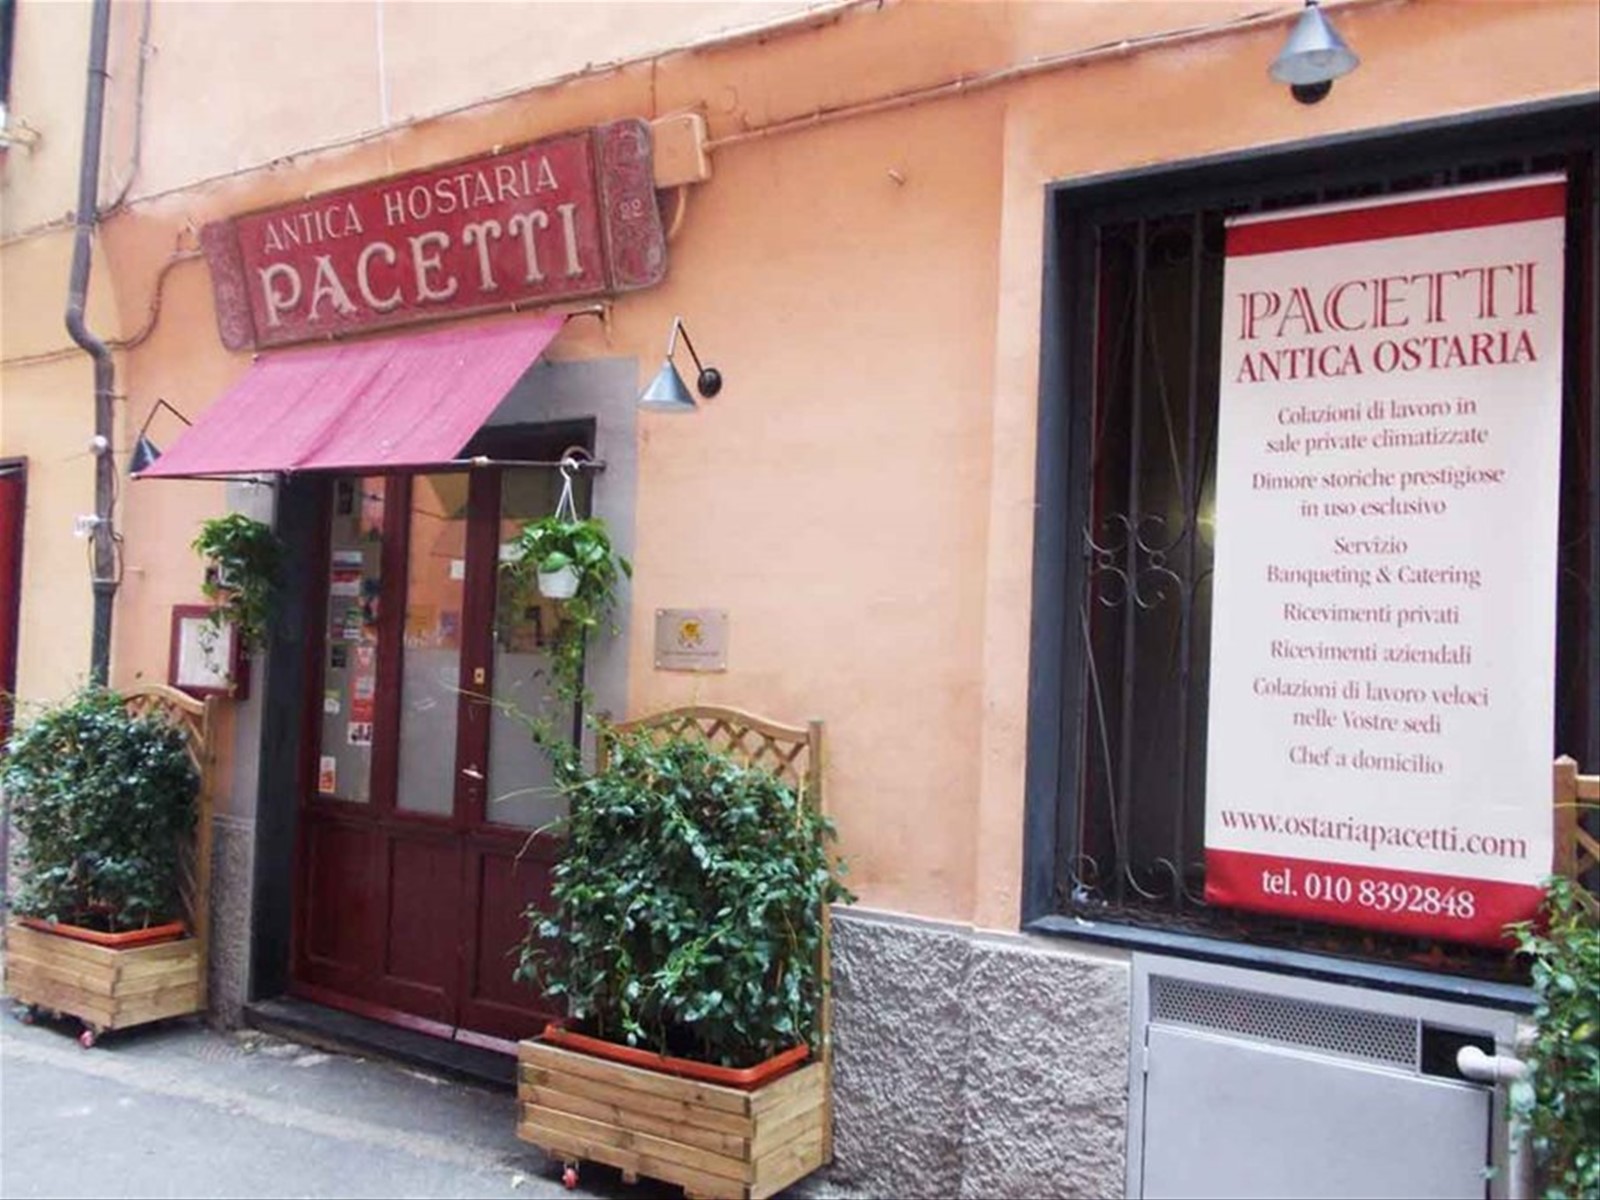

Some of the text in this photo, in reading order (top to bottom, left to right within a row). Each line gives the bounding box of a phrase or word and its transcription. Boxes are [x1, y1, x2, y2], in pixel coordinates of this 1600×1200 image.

[263, 155, 559, 254] ANTICA HOSTARIA
[258, 203, 583, 328] PACETTI
[1238, 261, 1538, 340] PACETTI
[1235, 328, 1537, 383] ANTICA OSTARIA
[1277, 396, 1477, 425] Colazioni di lavoro in
[1266, 426, 1489, 456] sale private climatizzate
[1252, 463, 1506, 491] Dimore storiche prestigiose
[1300, 497, 1447, 517] in uso esclusivo
[1333, 536, 1408, 555] Servizio
[1266, 564, 1482, 589] Banqueting & Catering
[1283, 602, 1459, 628] Ricevimenti privati
[1270, 640, 1472, 664] Ricevimenti aziendali
[1252, 677, 1489, 707] Colazioni di lavoro veloci
[1293, 707, 1441, 734] nelle Vostre sedi
[1288, 745, 1444, 774] Chef a domicilio
[1220, 809, 1527, 859] www.ostariapacetti.com
[1262, 868, 1475, 919] tel. 010 8392848
